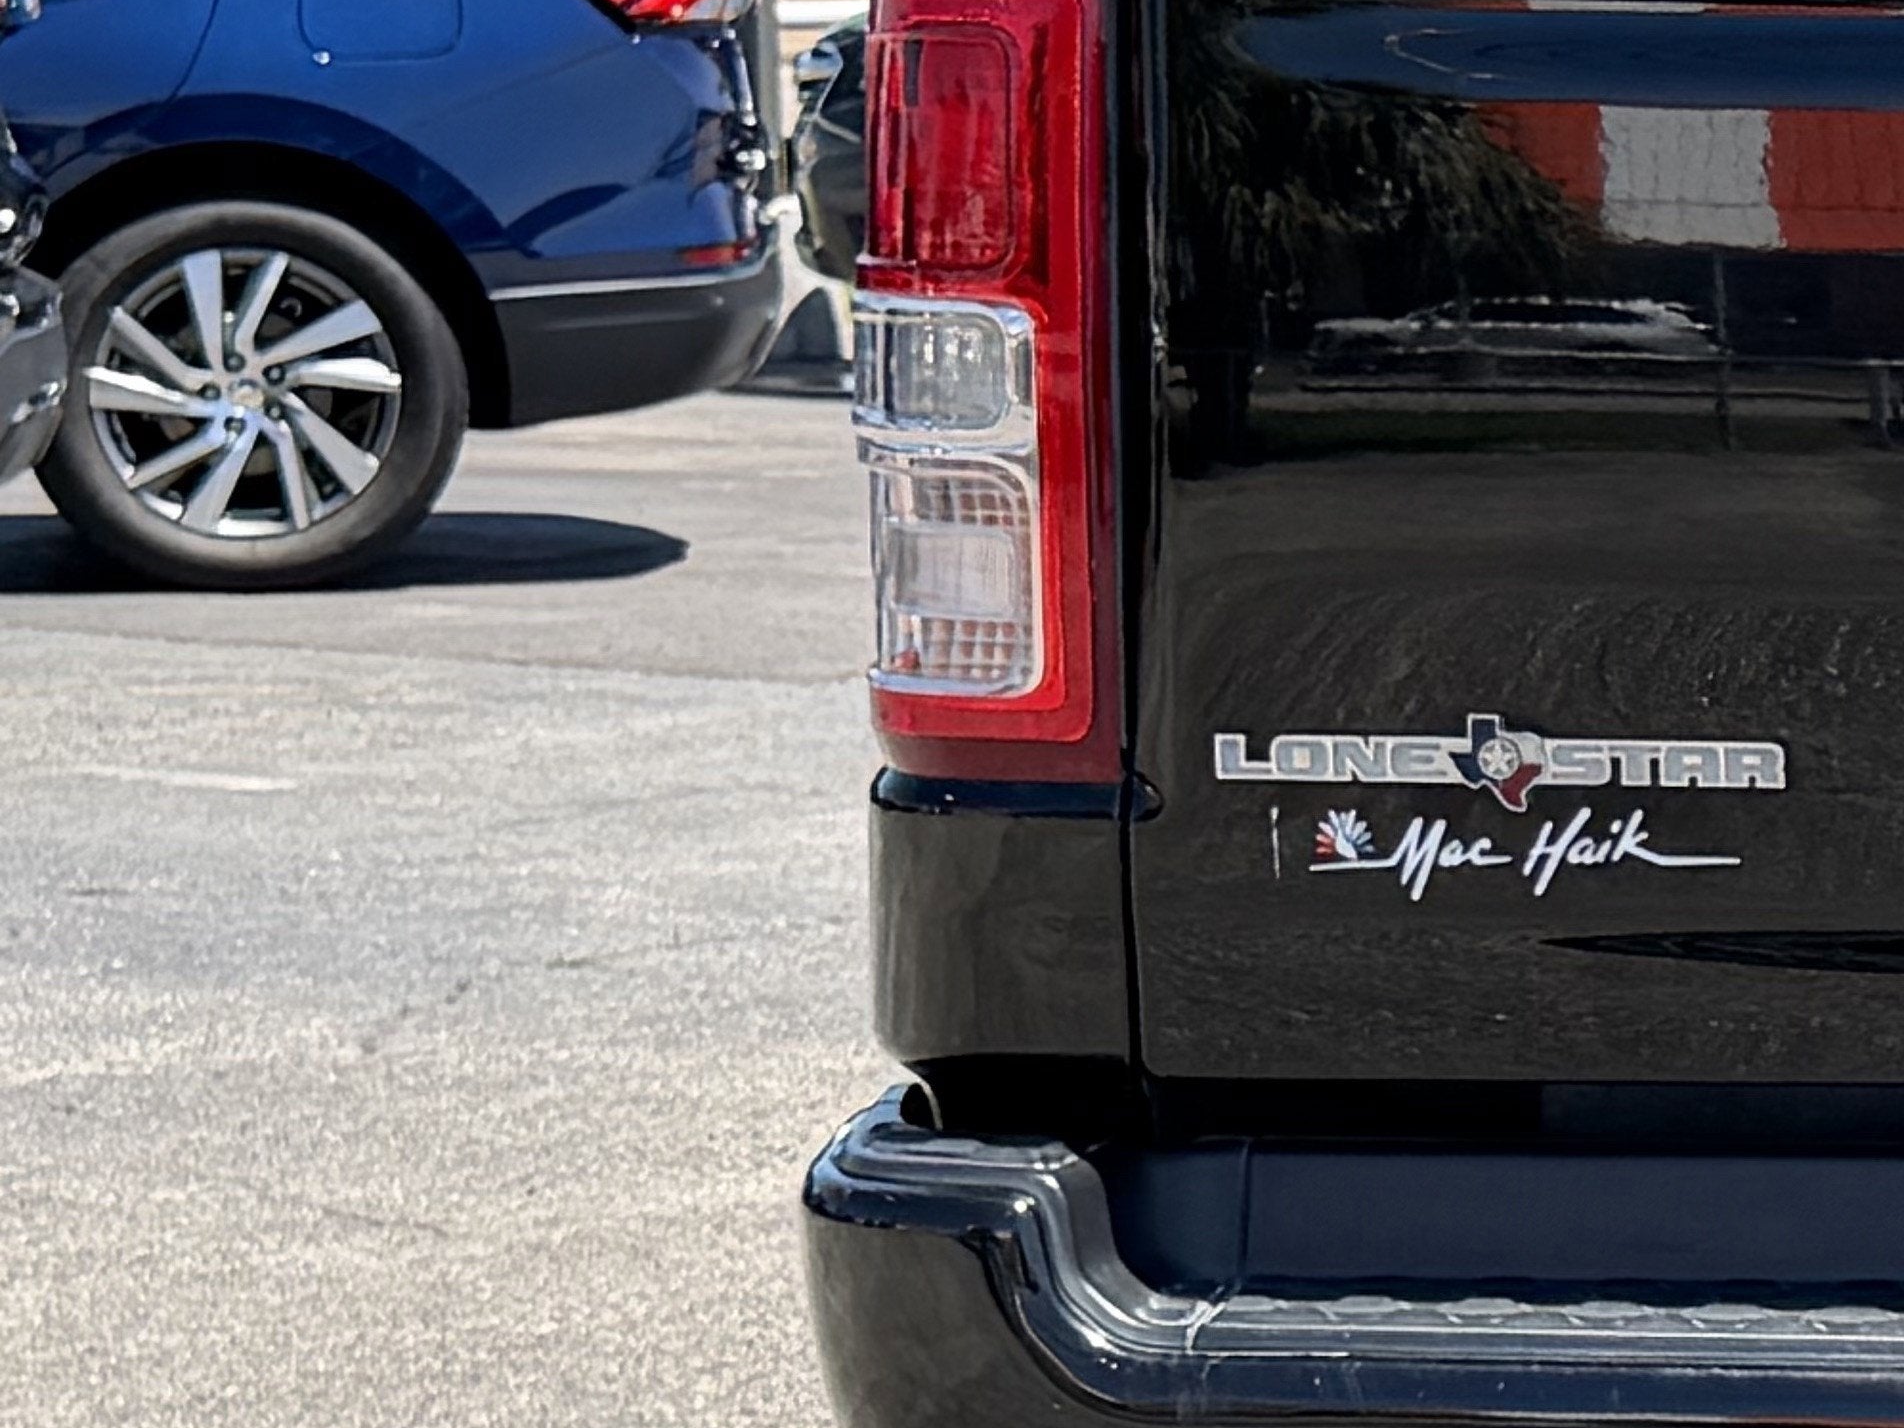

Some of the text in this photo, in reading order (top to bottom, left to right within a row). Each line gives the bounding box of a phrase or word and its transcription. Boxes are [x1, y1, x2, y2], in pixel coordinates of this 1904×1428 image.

[1214, 732, 1787, 789] LONE STAR
[1375, 806, 1665, 902] Mac Haik
